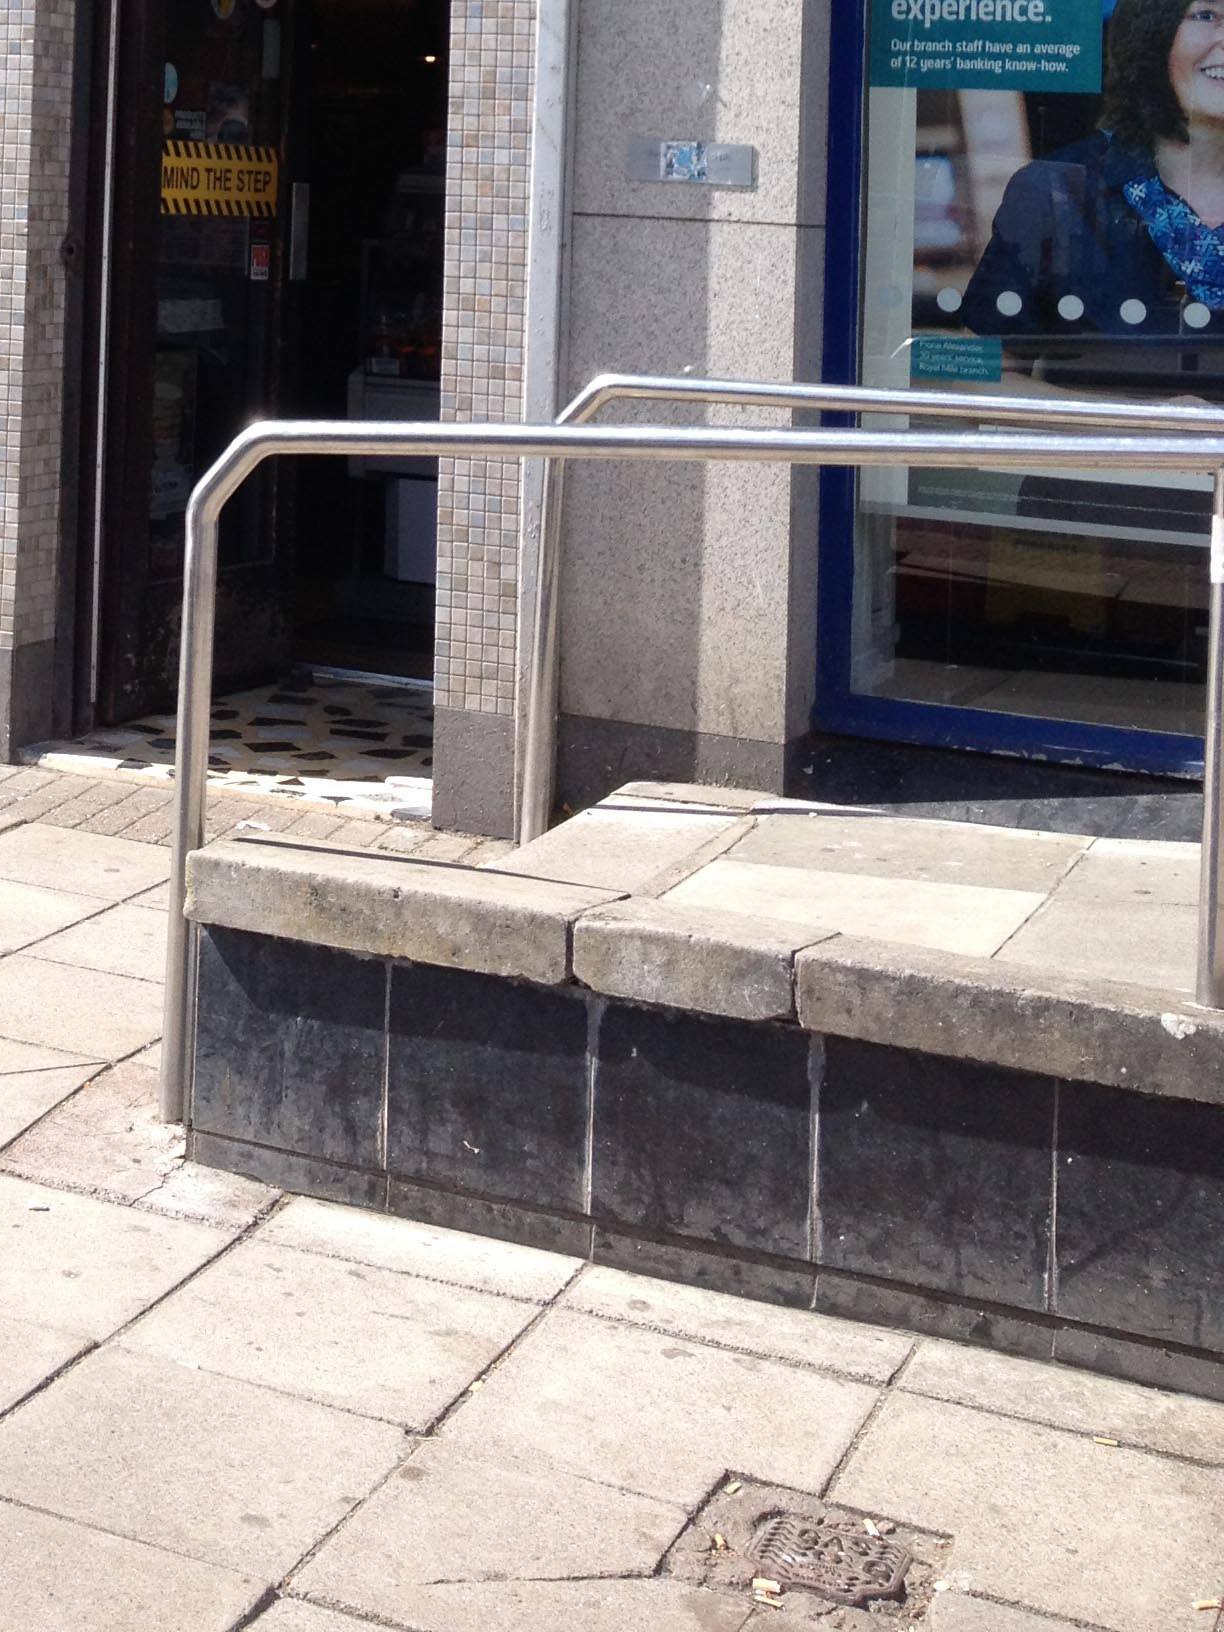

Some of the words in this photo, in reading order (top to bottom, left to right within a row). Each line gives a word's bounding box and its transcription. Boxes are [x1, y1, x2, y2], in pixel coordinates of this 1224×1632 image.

[891, 38, 911, 51] Our
[913, 39, 953, 52] branch
[956, 39, 983, 53] staff
[985, 40, 1013, 54] have
[1016, 43, 1031, 54] an
[1034, 43, 1081, 58] average
[890, 56, 902, 68] of
[905, 56, 918, 68] 12
[956, 58, 1002, 74] banking
[1005, 59, 1069, 73] know-how.
[162, 165, 200, 190] MIND
[205, 168, 232, 191] THE
[236, 170, 272, 193] STEP
